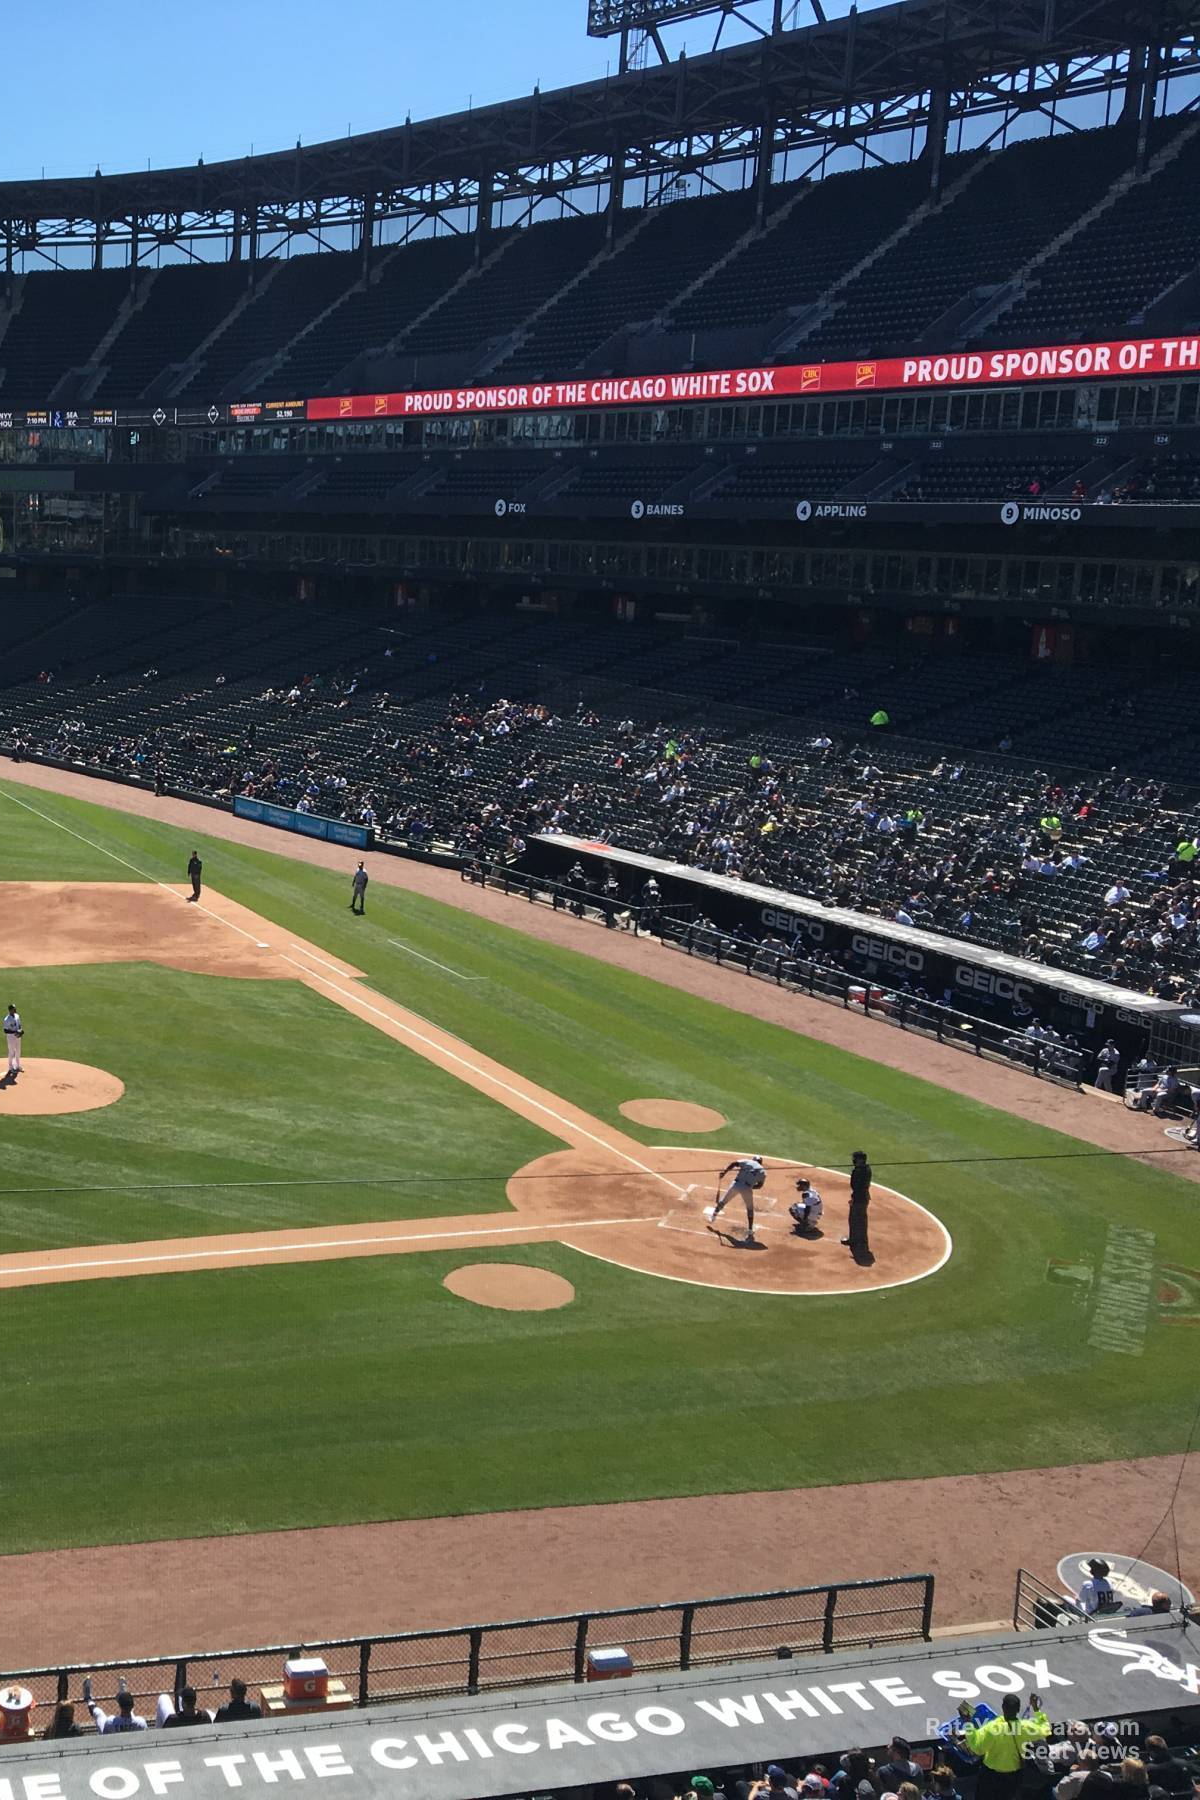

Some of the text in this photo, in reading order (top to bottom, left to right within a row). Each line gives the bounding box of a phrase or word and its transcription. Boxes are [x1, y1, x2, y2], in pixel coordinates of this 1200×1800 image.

[902, 356, 984, 383] PROUD
[989, 346, 1110, 379] SPONSOR
[1118, 343, 1155, 369] OF
[404, 371, 775, 412] PROUD SPONSOR OF THE CHICAGO WHITE SOX
[65, 411, 79, 419] SEA
[508, 503, 526, 513] FOX
[646, 504, 685, 515] BAINES
[800, 505, 867, 518] 4 APPLING
[1005, 507, 1081, 521] 9 MINOSO
[761, 908, 824, 942] GEICO
[852, 934, 925, 972] GEICO
[1059, 991, 1105, 1016] GEICO
[90, 1658, 1075, 1800] OF THE CHICAGO WHITE SOX
